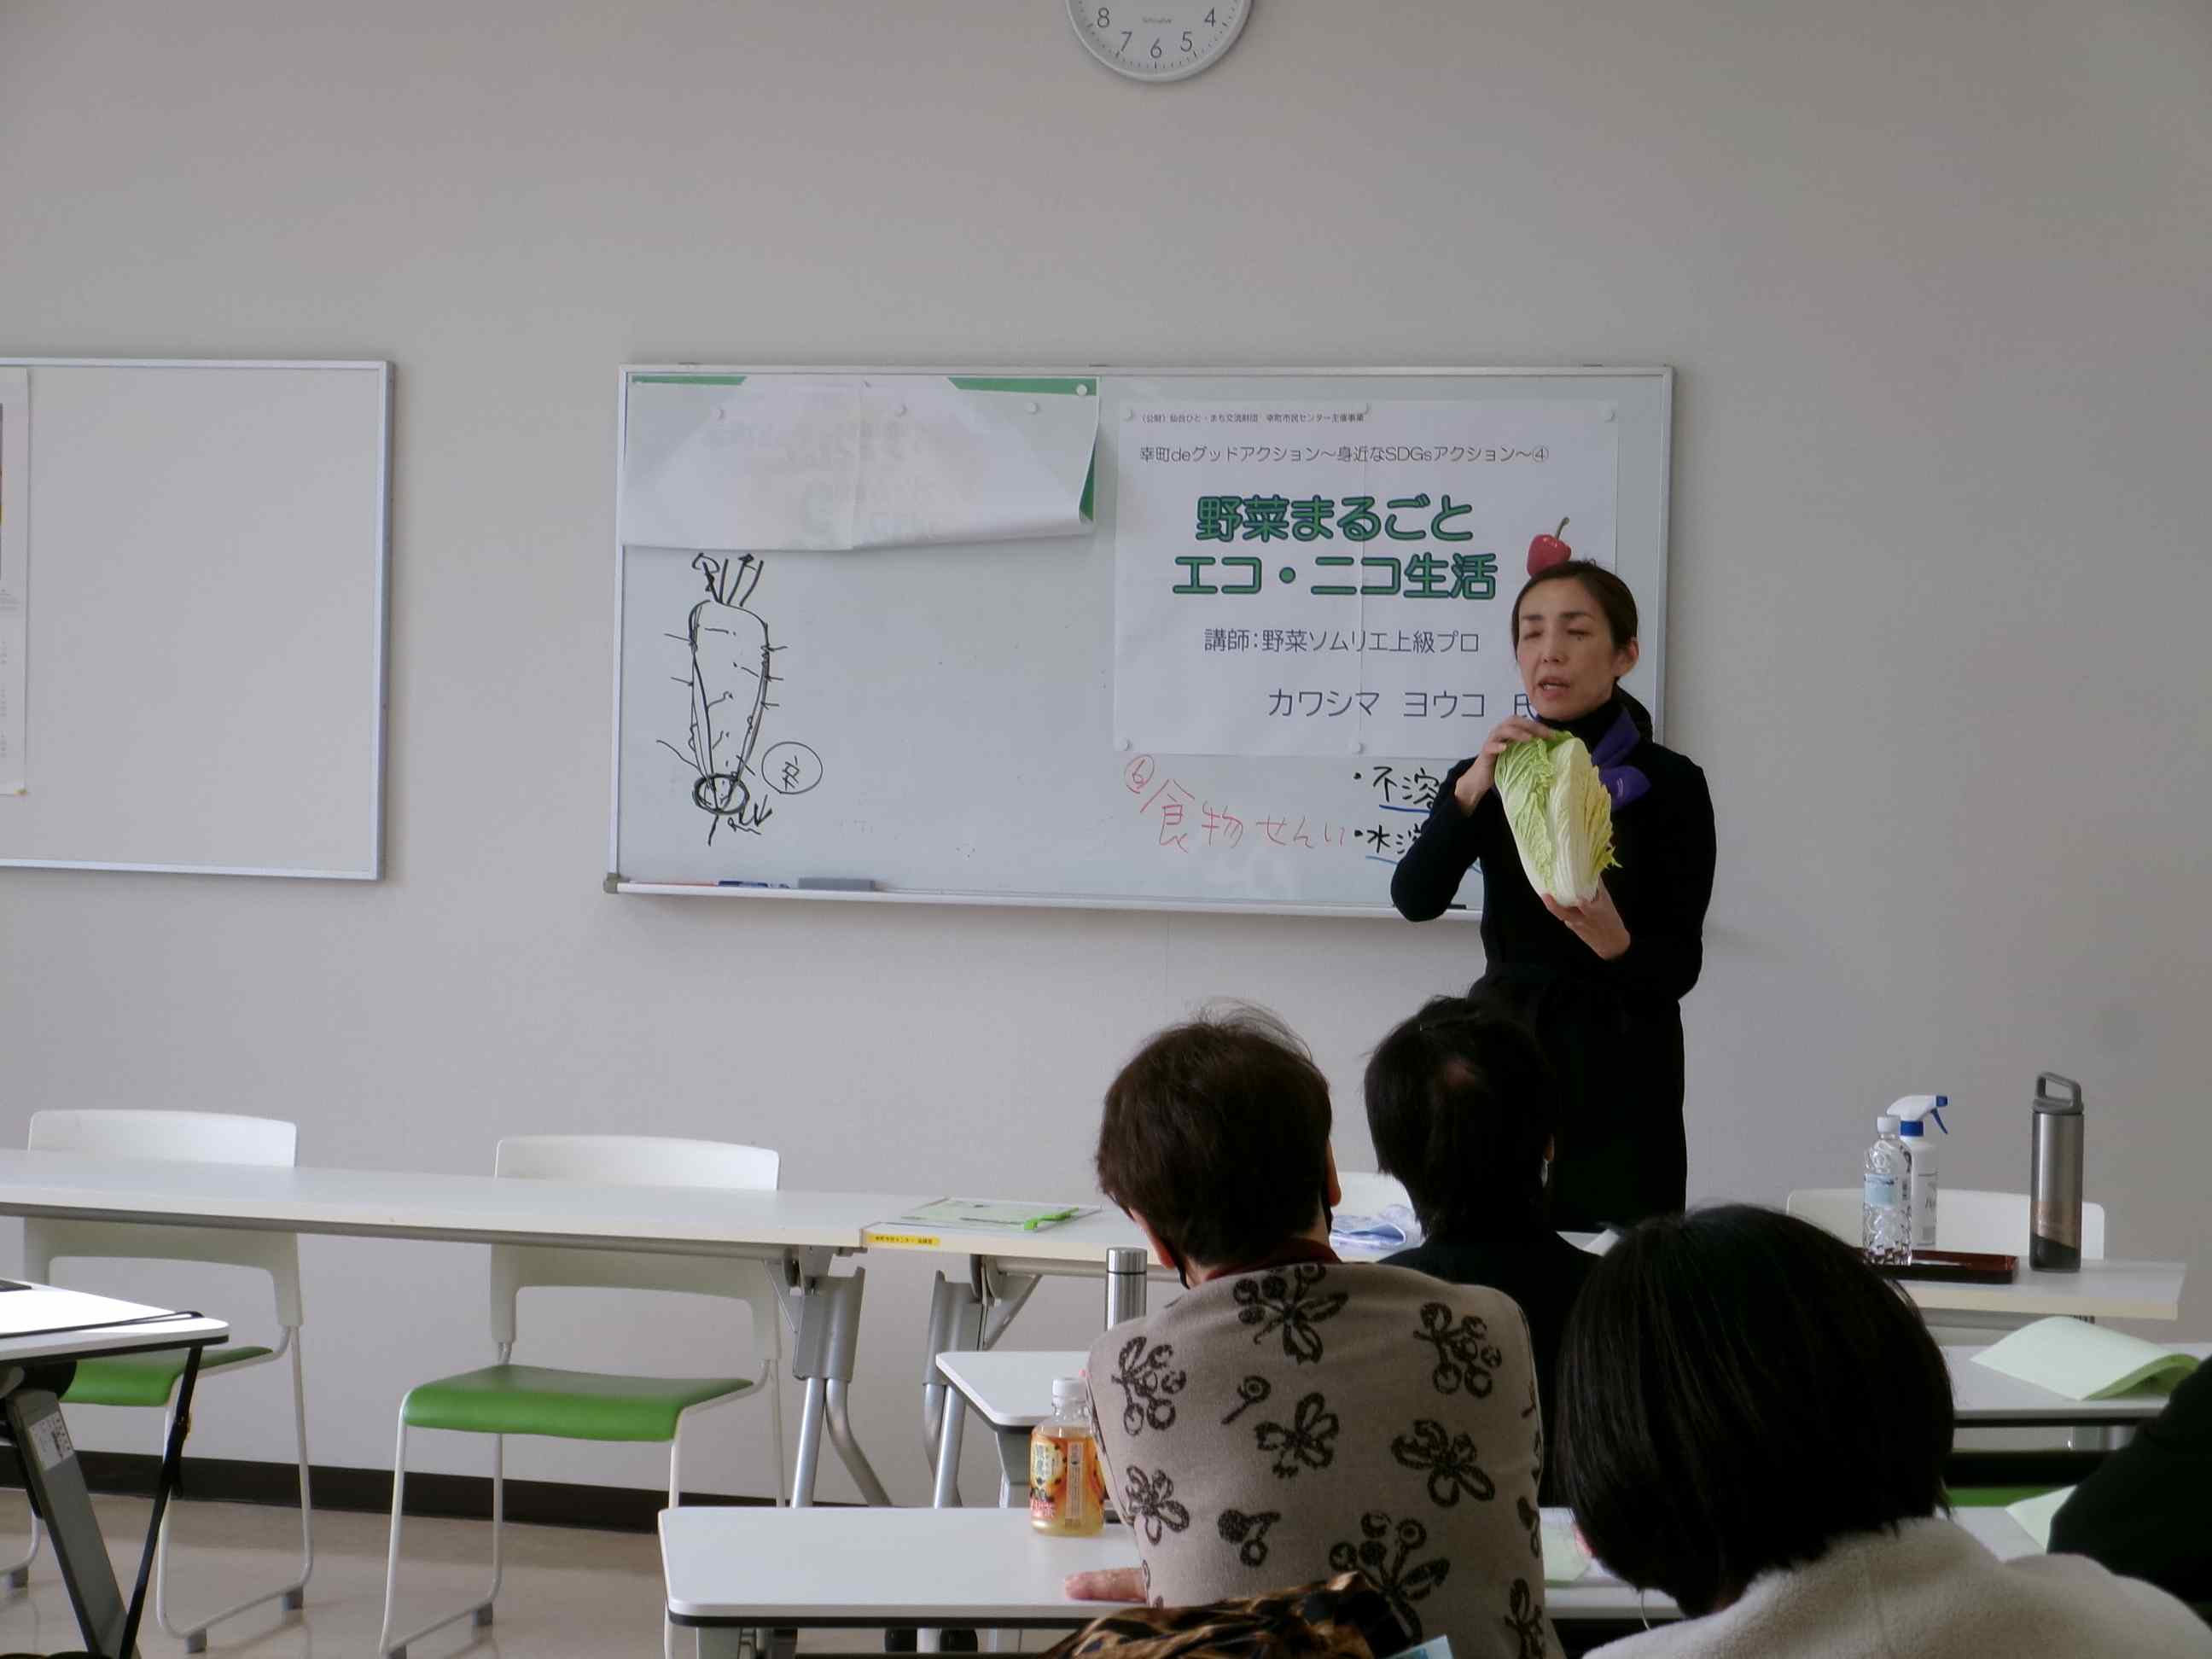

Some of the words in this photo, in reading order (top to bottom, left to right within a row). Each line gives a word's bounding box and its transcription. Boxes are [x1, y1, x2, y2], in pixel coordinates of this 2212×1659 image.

[1097, 7, 1110, 28] 8
[1204, 7, 1217, 27] 4
[1121, 31, 1133, 52] 7
[1150, 38, 1162, 58] 6
[1180, 31, 1193, 52] 5
[1196, 494, 1474, 542] 野菜まるごと
[1173, 552, 1498, 601] エコ・ニコ生活
[1268, 690, 1379, 719] カワシマ
[1404, 690, 1486, 719] ヨウコ
